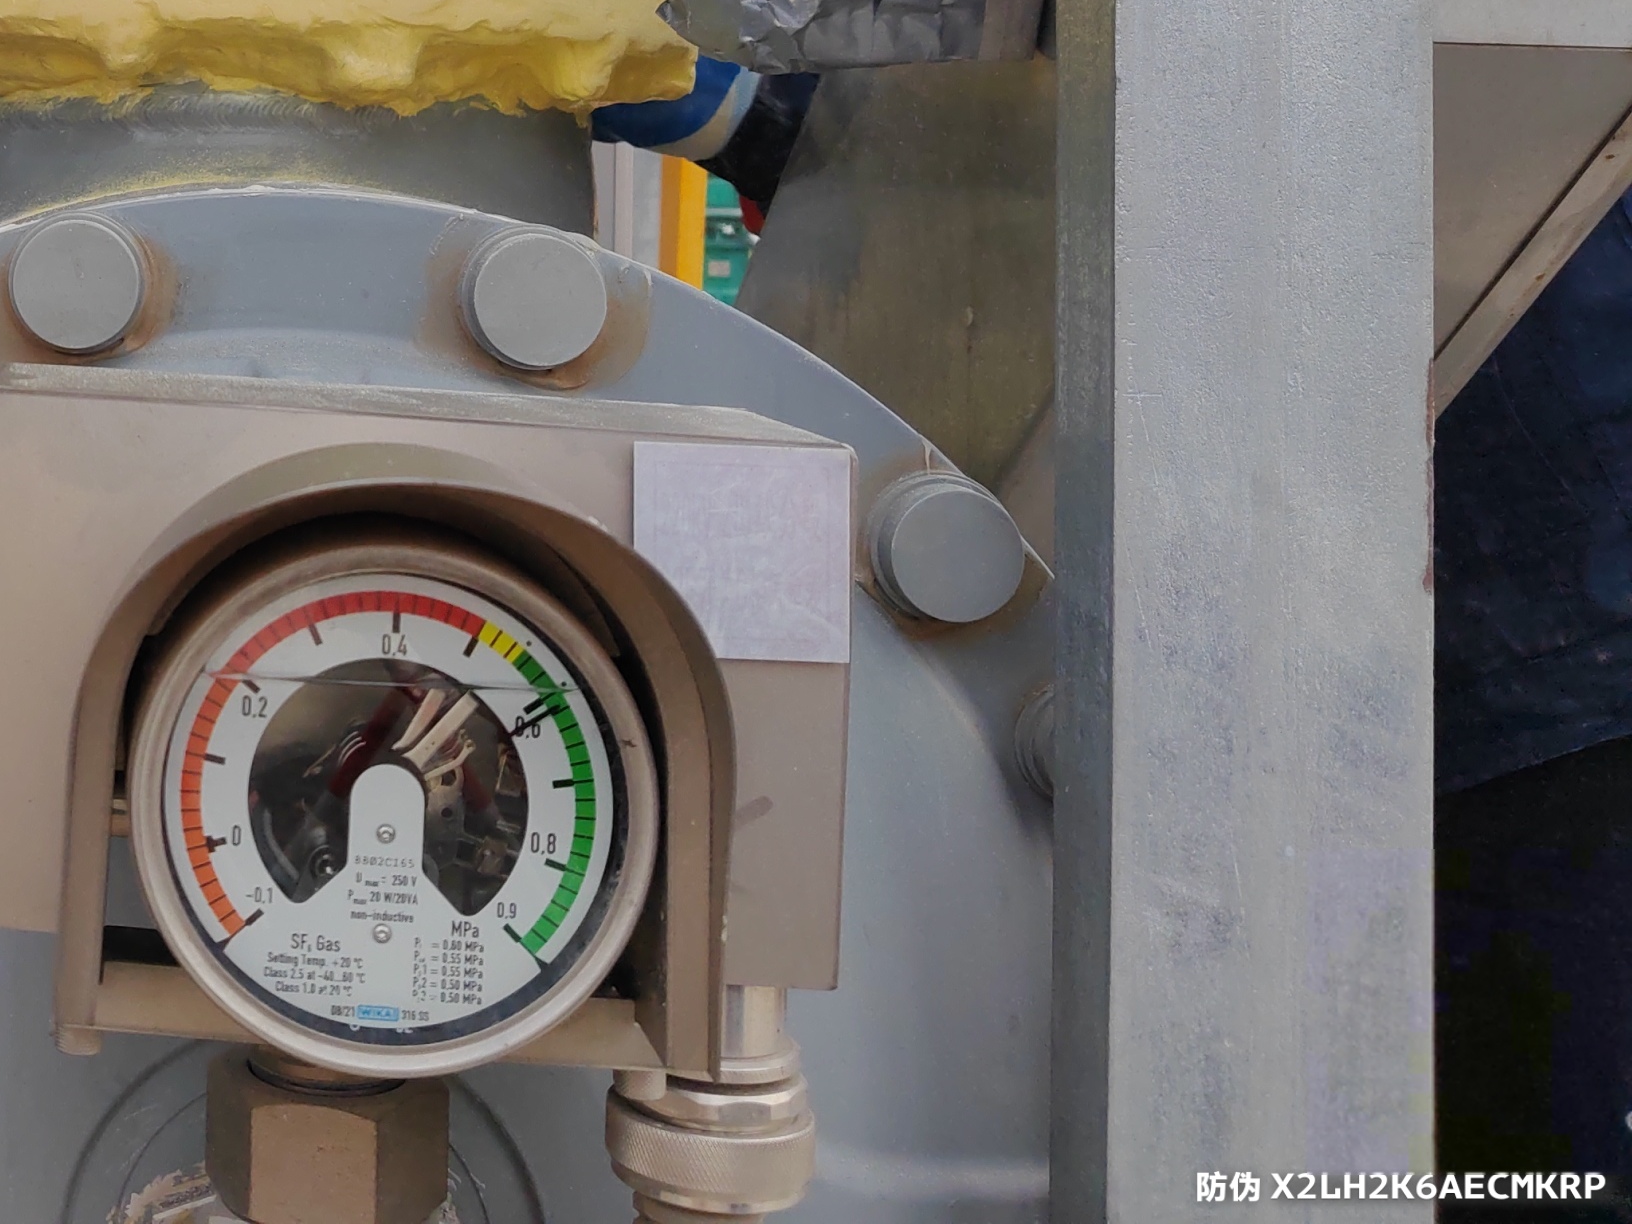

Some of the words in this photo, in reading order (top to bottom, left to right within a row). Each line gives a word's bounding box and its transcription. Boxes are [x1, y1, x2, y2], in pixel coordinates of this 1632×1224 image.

[232, 824, 242, 847] 0
[451, 920, 480, 938] MPa
[316, 934, 341, 952] Gas
